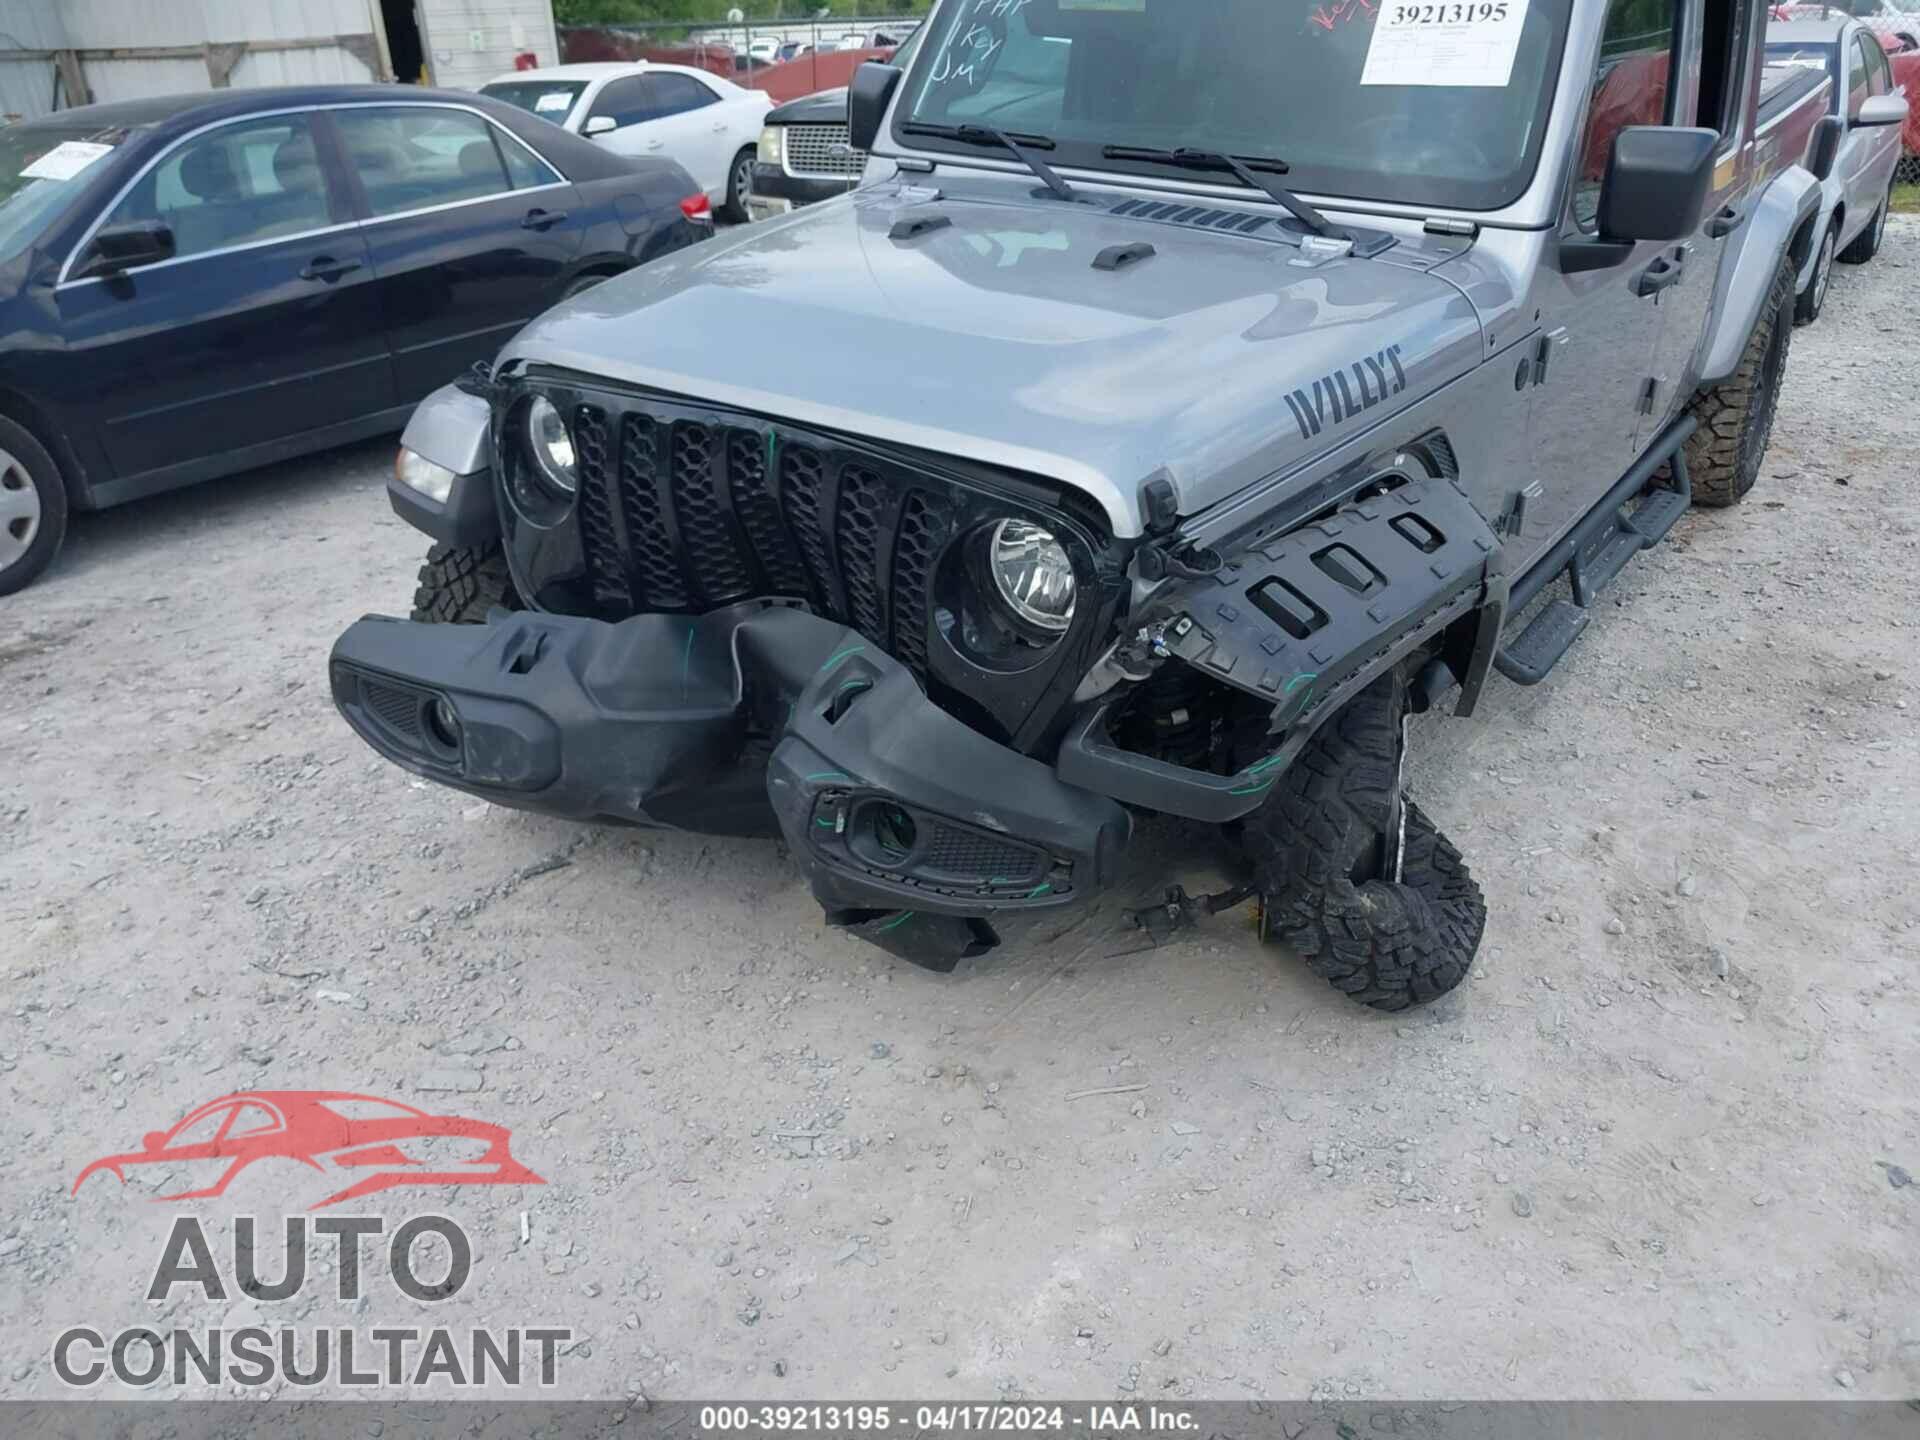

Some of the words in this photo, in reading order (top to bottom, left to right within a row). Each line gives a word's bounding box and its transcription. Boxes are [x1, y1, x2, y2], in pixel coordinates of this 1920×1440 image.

[1391, 2, 1508, 25] 39213195
[960, 22, 1002, 61] Key
[1283, 343, 1406, 440] WILLYS
